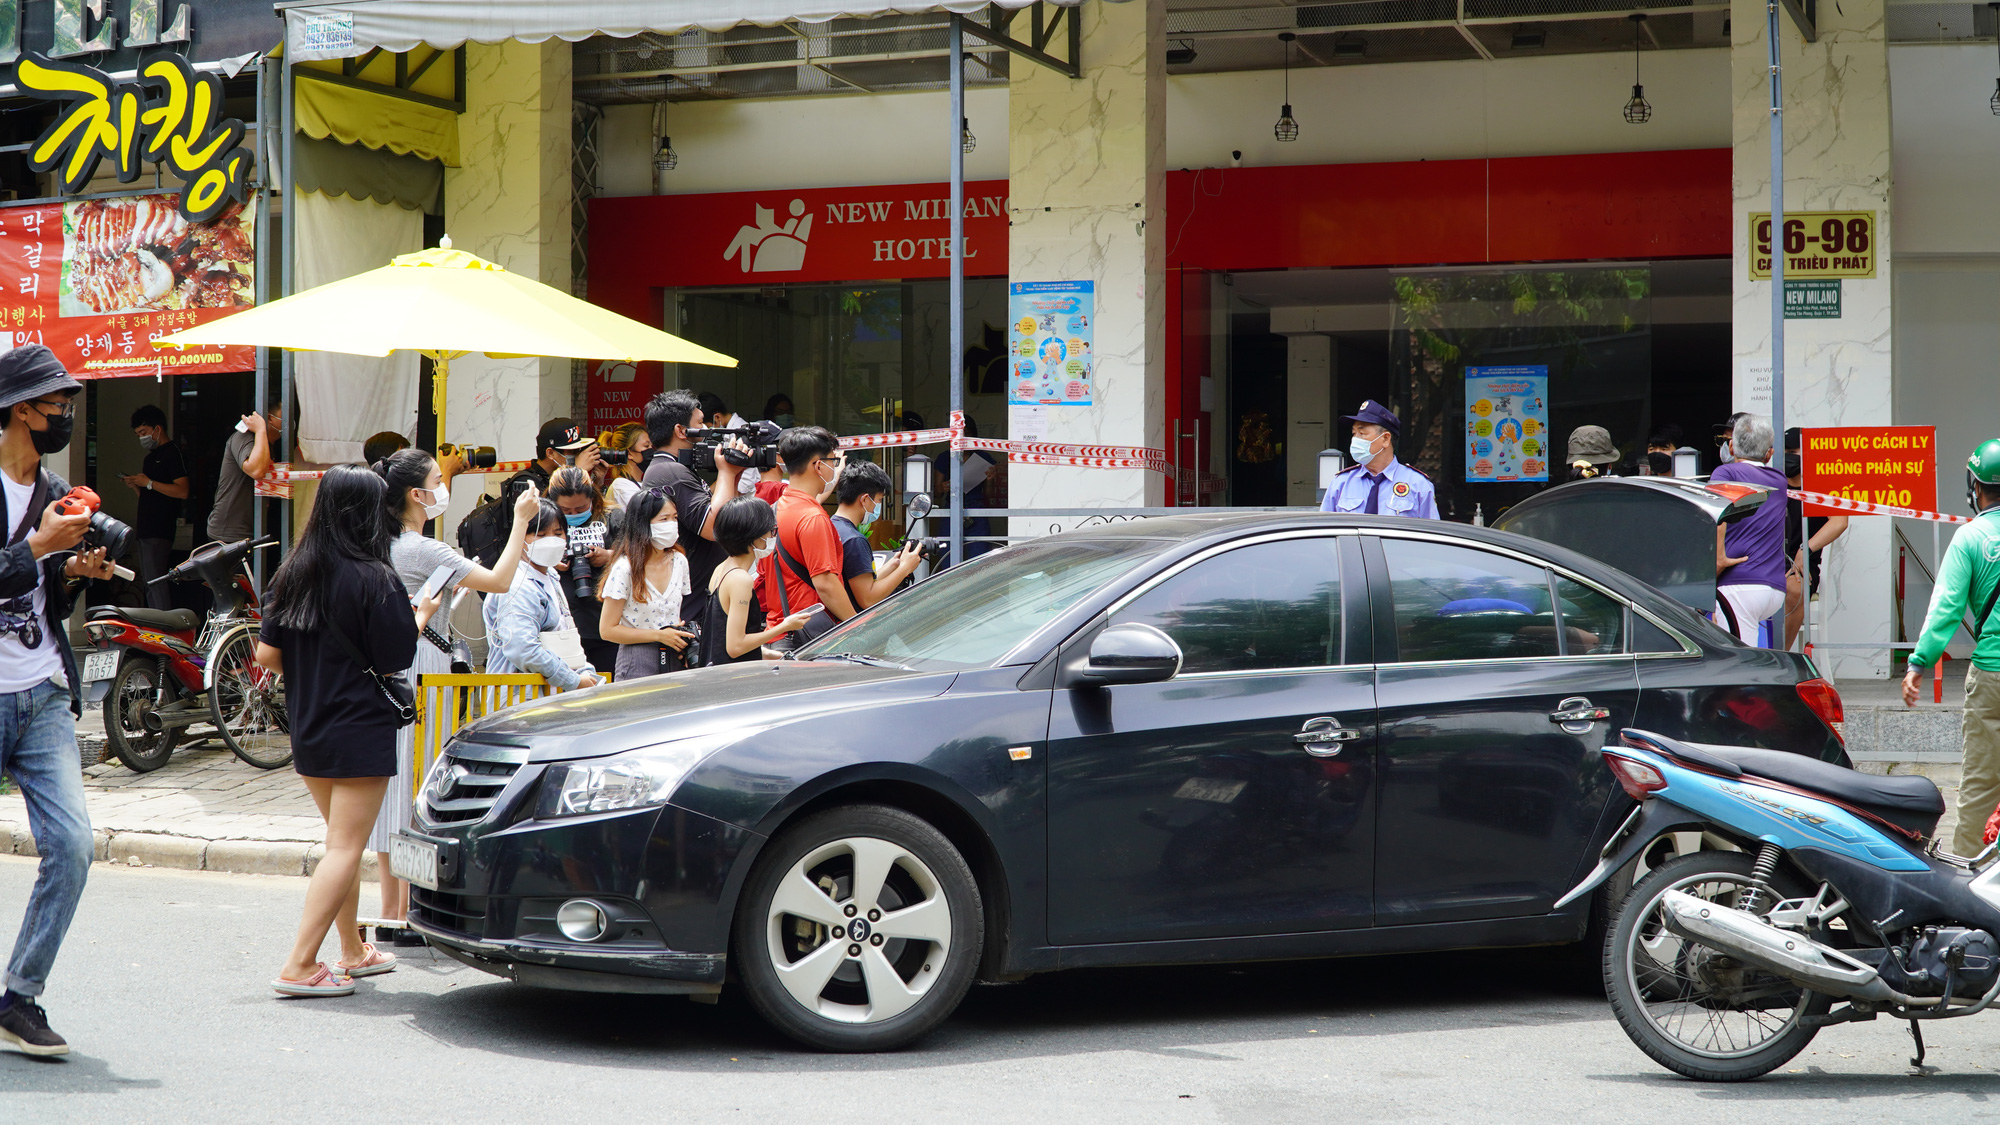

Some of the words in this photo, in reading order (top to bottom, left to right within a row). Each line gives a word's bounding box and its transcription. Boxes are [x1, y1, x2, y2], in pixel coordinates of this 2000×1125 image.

[826, 201, 894, 224] NEW
[1757, 218, 1869, 255] 96-98
[873, 236, 978, 261] HOTEL
[1789, 253, 1829, 270] TRIỀU
[1833, 254, 1868, 270] PHÁT
[1786, 290, 1805, 304] NEW
[1806, 290, 1838, 304] MILANO
[107, 315, 128, 330] 서울
[134, 315, 150, 328] 3대
[603, 391, 632, 402] NEW
[593, 407, 641, 419] MILANO
[1810, 437, 1838, 450] KHU
[1842, 435, 1869, 452] VỰC
[1873, 432, 1908, 449] CÁCH
[1912, 436, 1928, 449] LY
[1816, 458, 1862, 475] KHÔNG
[1866, 458, 1902, 477] PHẬN
[1905, 459, 1924, 477] SỰ
[1874, 484, 1912, 507] VÀO
[88, 665, 112, 679] 0057
